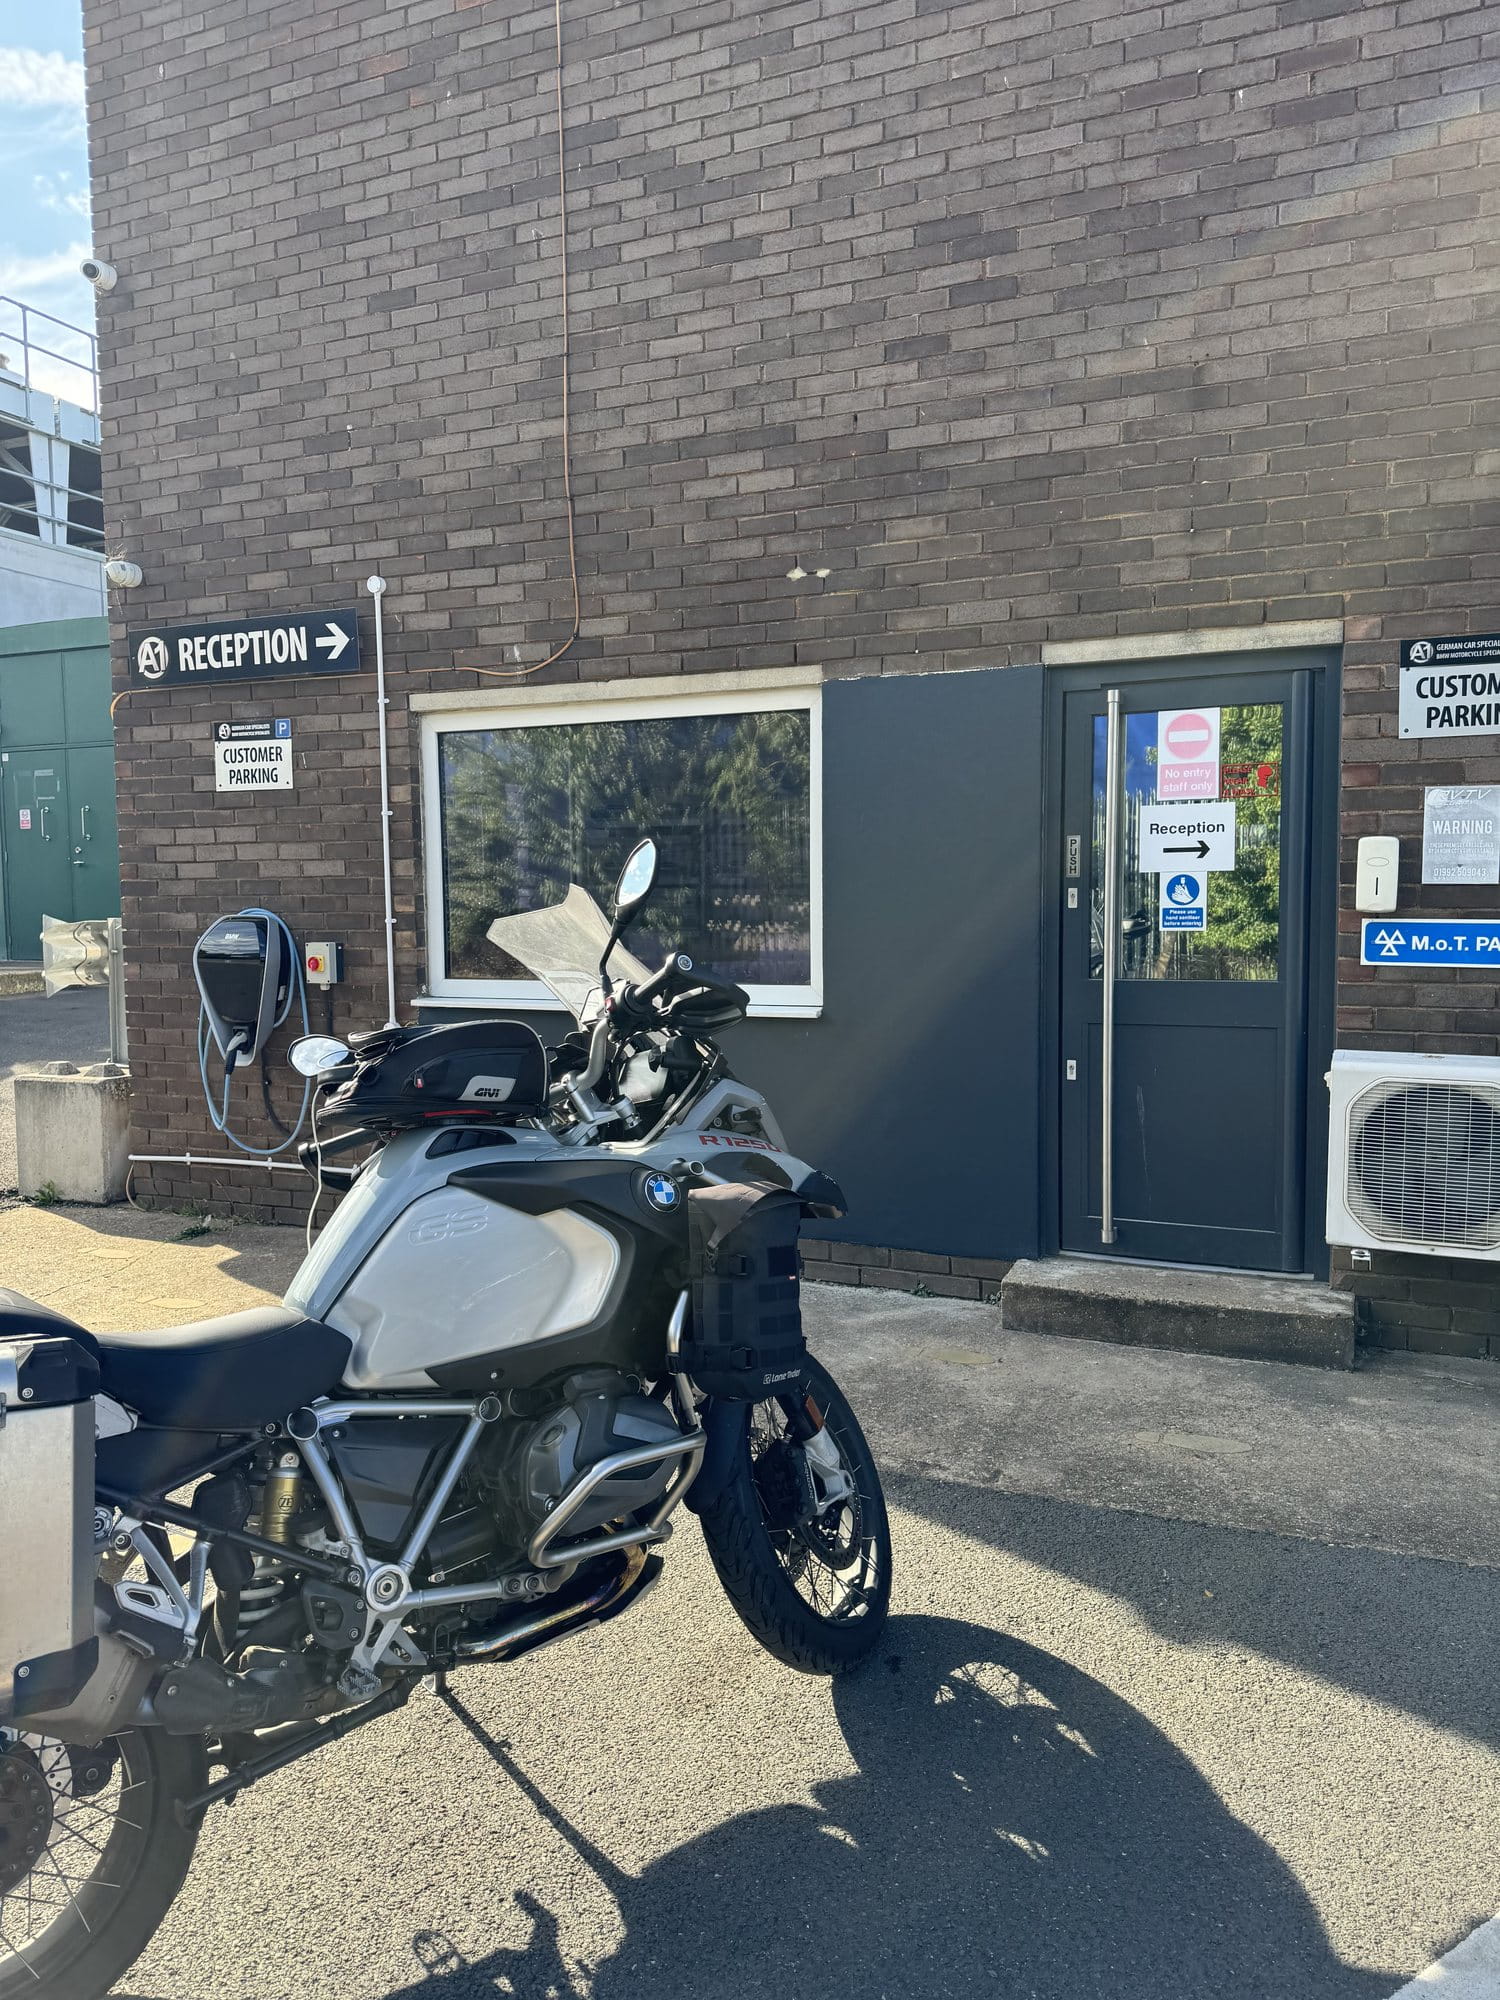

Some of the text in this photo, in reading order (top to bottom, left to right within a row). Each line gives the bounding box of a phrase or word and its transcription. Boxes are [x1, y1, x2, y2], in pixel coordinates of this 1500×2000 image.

[178, 626, 308, 672] RECEPTION
[1436, 642, 1463, 651] GERMAN
[1464, 641, 1476, 649] CAR
[1450, 651, 1482, 659] MOTORCYCLE
[279, 722, 287, 735] P
[223, 746, 283, 764] CUSTOMER
[229, 767, 278, 785] PARKING
[1165, 767, 1211, 779] No entry
[1163, 781, 1213, 792] staff only
[1149, 821, 1226, 837] Reception
[1432, 820, 1494, 835] WARNING
[1069, 838, 1077, 875] PUSH
[1411, 935, 1469, 951] M.o.T.
[474, 1087, 502, 1098] GIVI
[407, 1204, 489, 1247] GS
[771, 1373, 786, 1383] Lone
